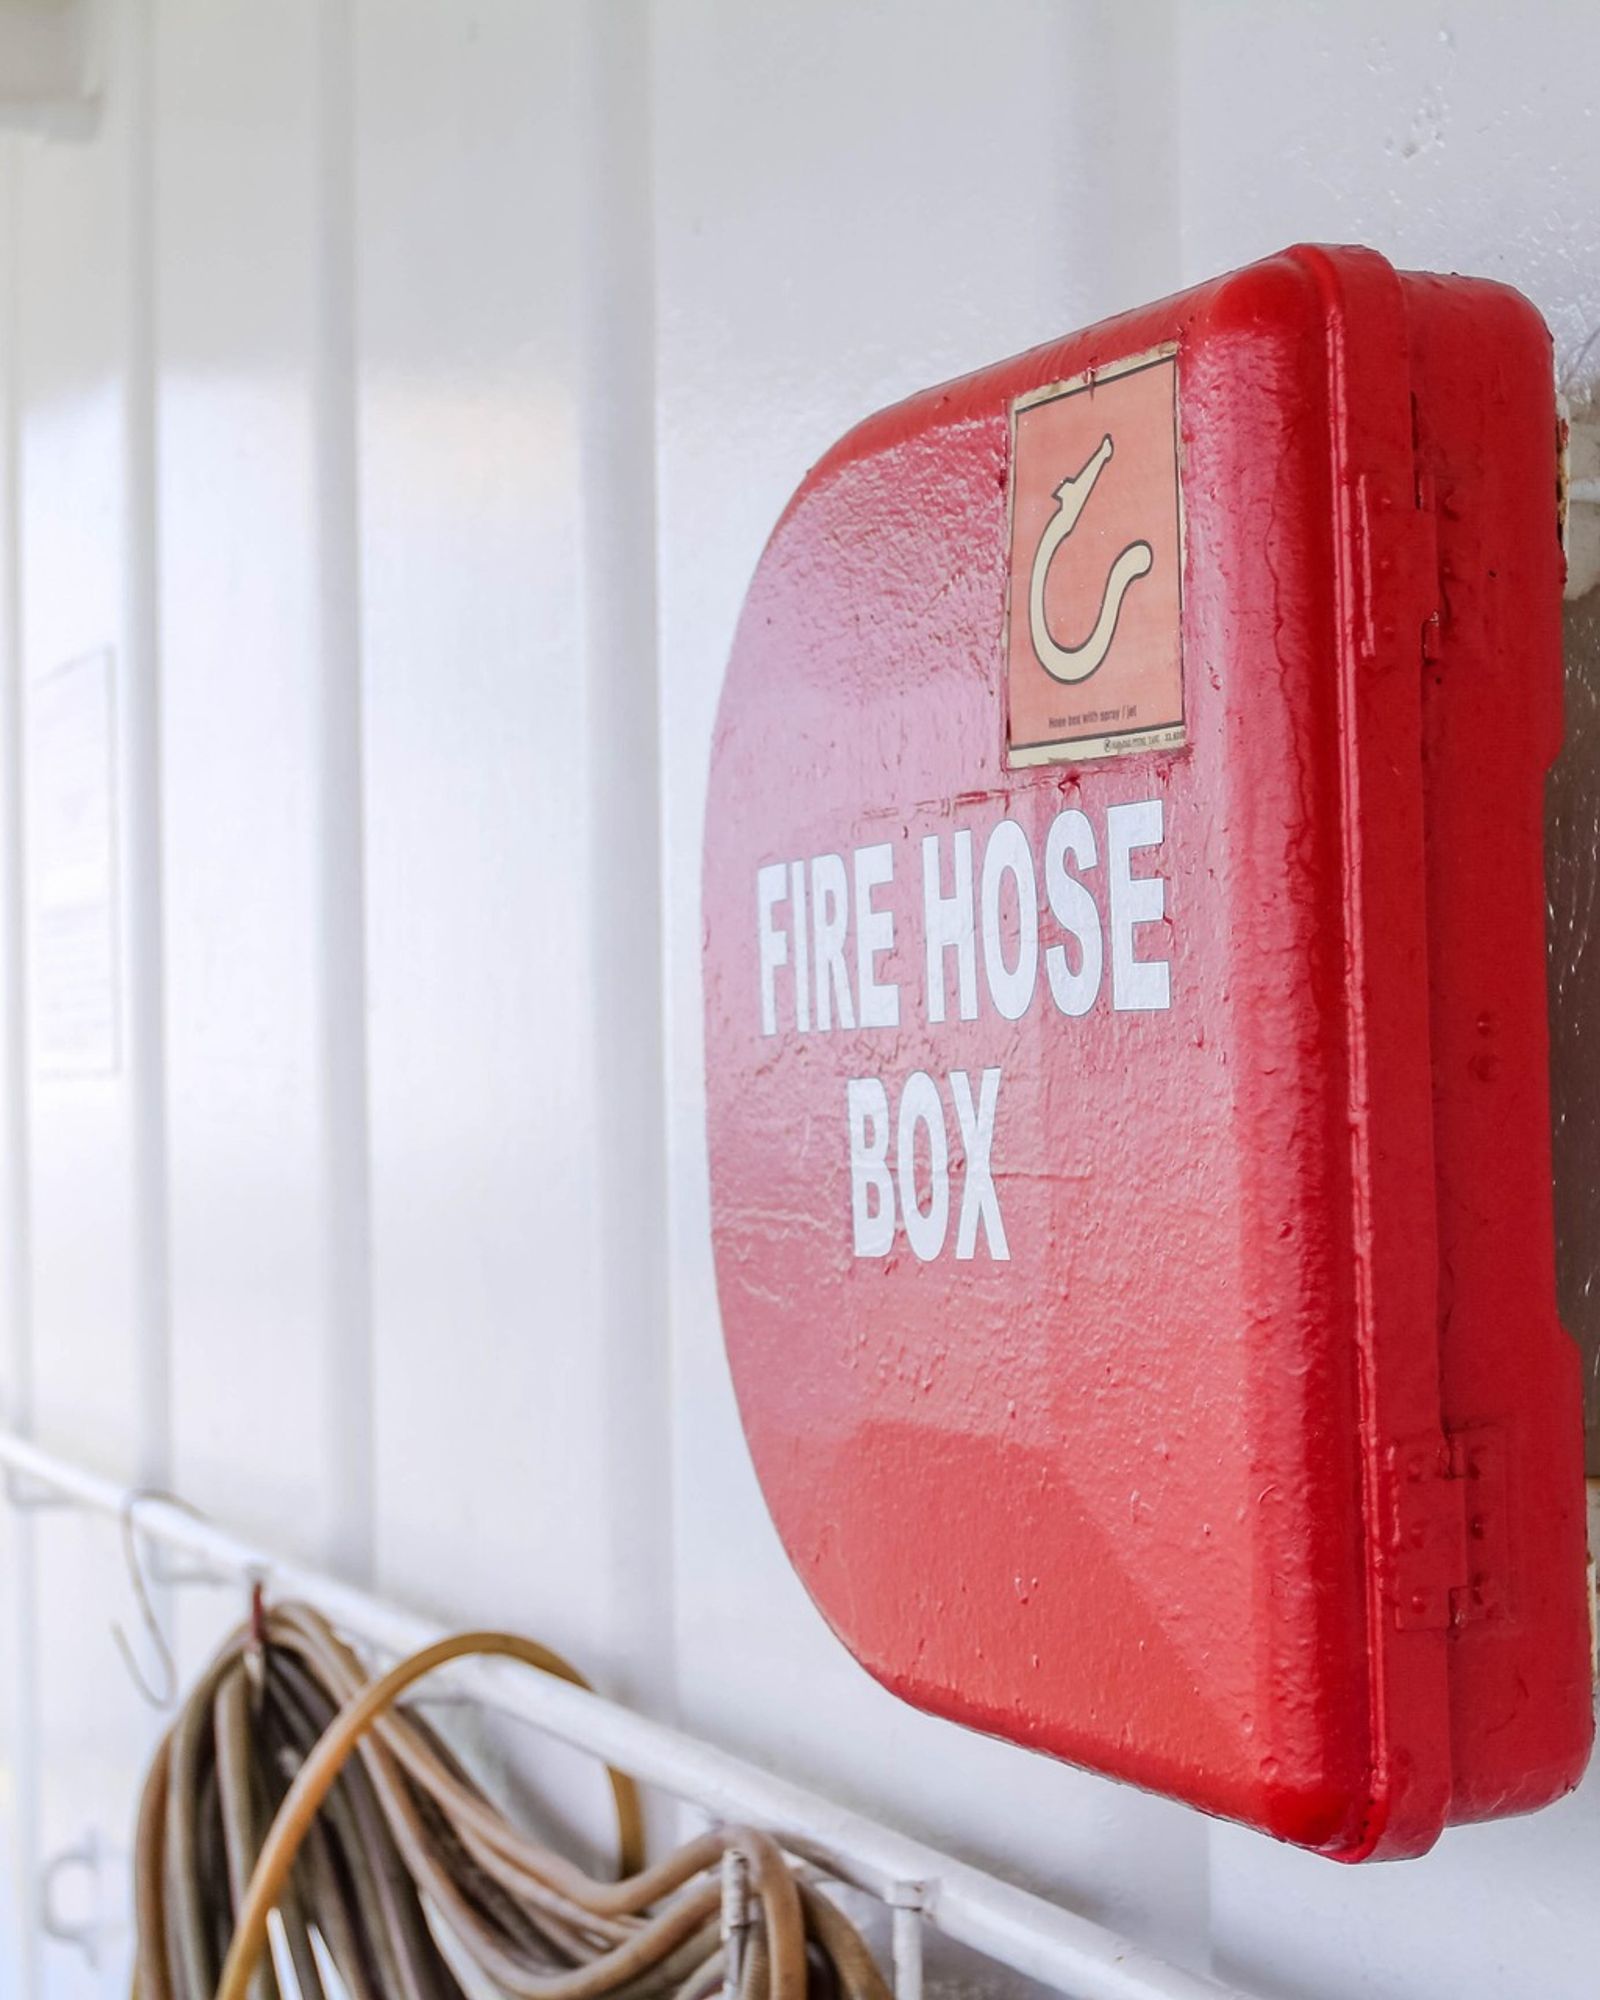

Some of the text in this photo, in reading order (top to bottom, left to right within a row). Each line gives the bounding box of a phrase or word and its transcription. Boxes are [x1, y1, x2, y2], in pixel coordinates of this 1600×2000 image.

[757, 800, 1171, 1036] FIRE HOSE
[847, 1067, 1010, 1261] BOX
